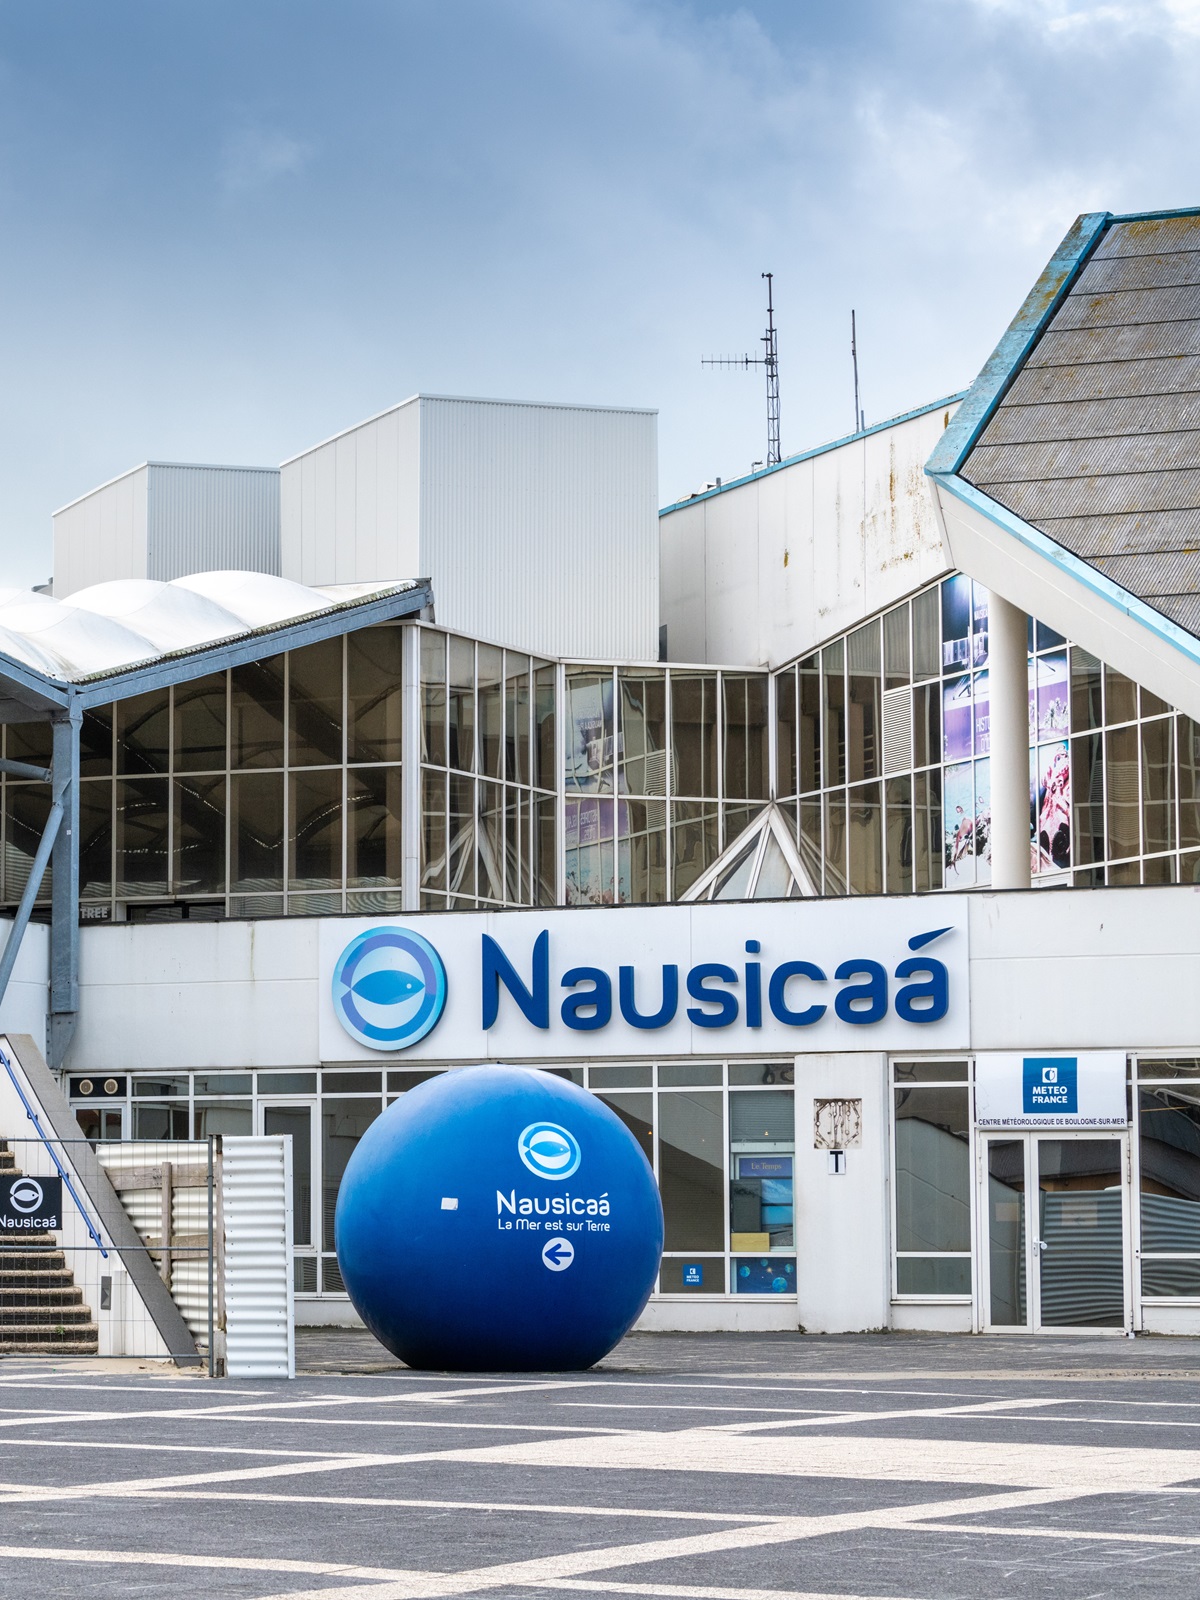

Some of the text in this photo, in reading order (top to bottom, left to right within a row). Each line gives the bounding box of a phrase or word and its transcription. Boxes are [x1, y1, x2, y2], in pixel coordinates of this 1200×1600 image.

[482, 926, 955, 1031] Nausicaá
[1032, 1085, 1068, 1095] METEO
[1032, 1095, 1068, 1104] FRANCE
[978, 1118, 1001, 1126] CENTRE
[1002, 1116, 1055, 1126] MÉTÉOROLOGIQUE
[1065, 1117, 1125, 1125] BOULOGNE-SUR-MER
[751, 1162, 782, 1171] Le Temps
[830, 1150, 843, 1173] T
[496, 1189, 611, 1216] Nausicaá
[498, 1218, 611, 1232] La Mer est sur Terre
